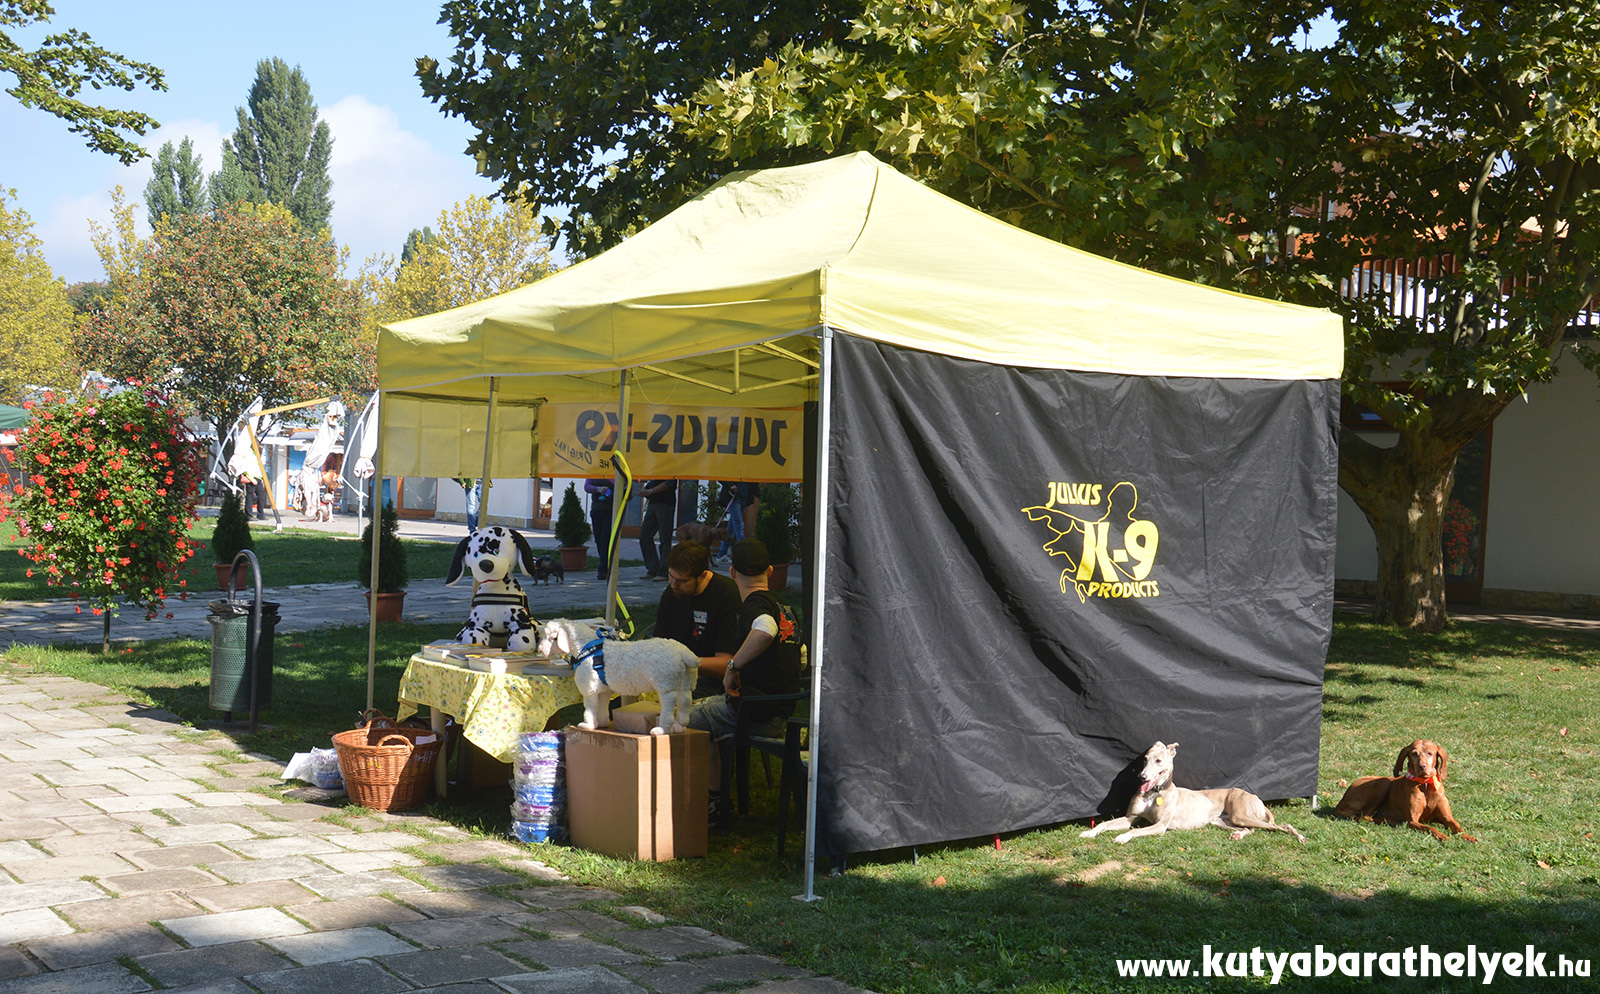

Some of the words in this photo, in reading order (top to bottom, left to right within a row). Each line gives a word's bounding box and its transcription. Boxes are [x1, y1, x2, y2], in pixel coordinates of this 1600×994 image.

[1045, 482, 1103, 509] JULIUS
[1075, 520, 1159, 582] K-9
[1087, 580, 1160, 599] PRODUCTS
